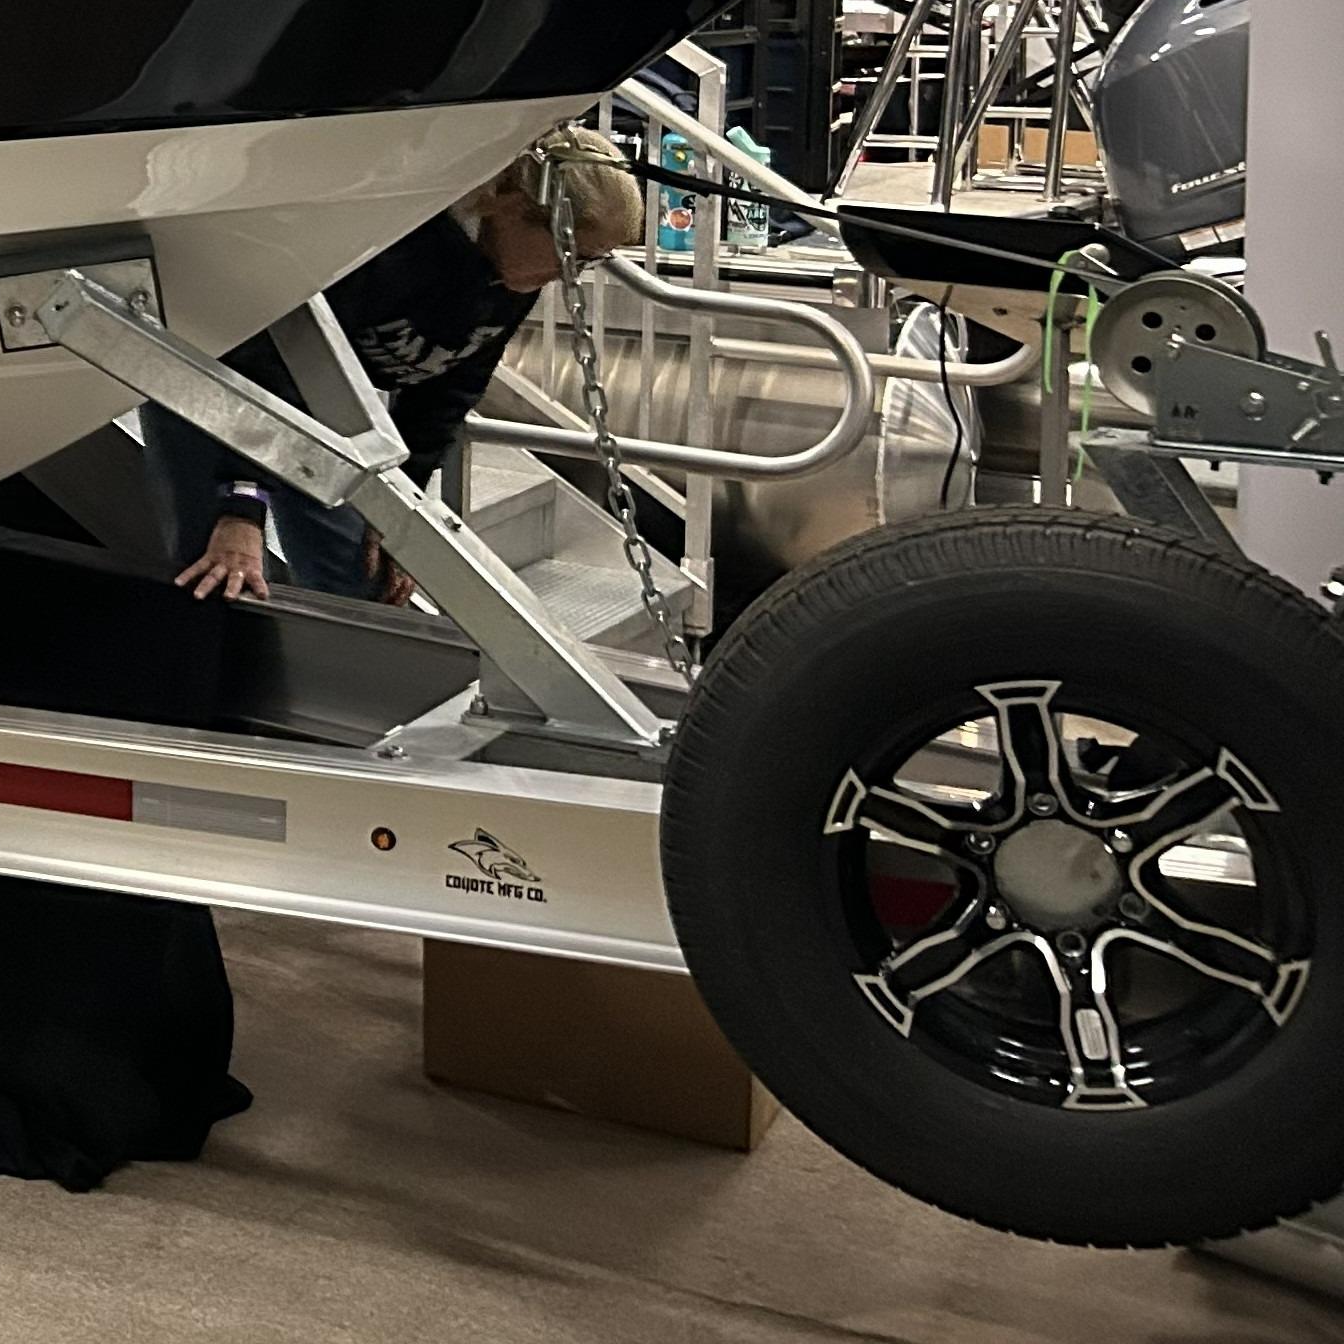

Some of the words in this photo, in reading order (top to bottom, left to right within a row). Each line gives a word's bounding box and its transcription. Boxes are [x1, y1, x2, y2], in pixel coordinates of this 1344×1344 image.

[445, 874, 494, 895] COYOTE
[497, 882, 524, 900] MFG
[527, 887, 548, 905] CO.
